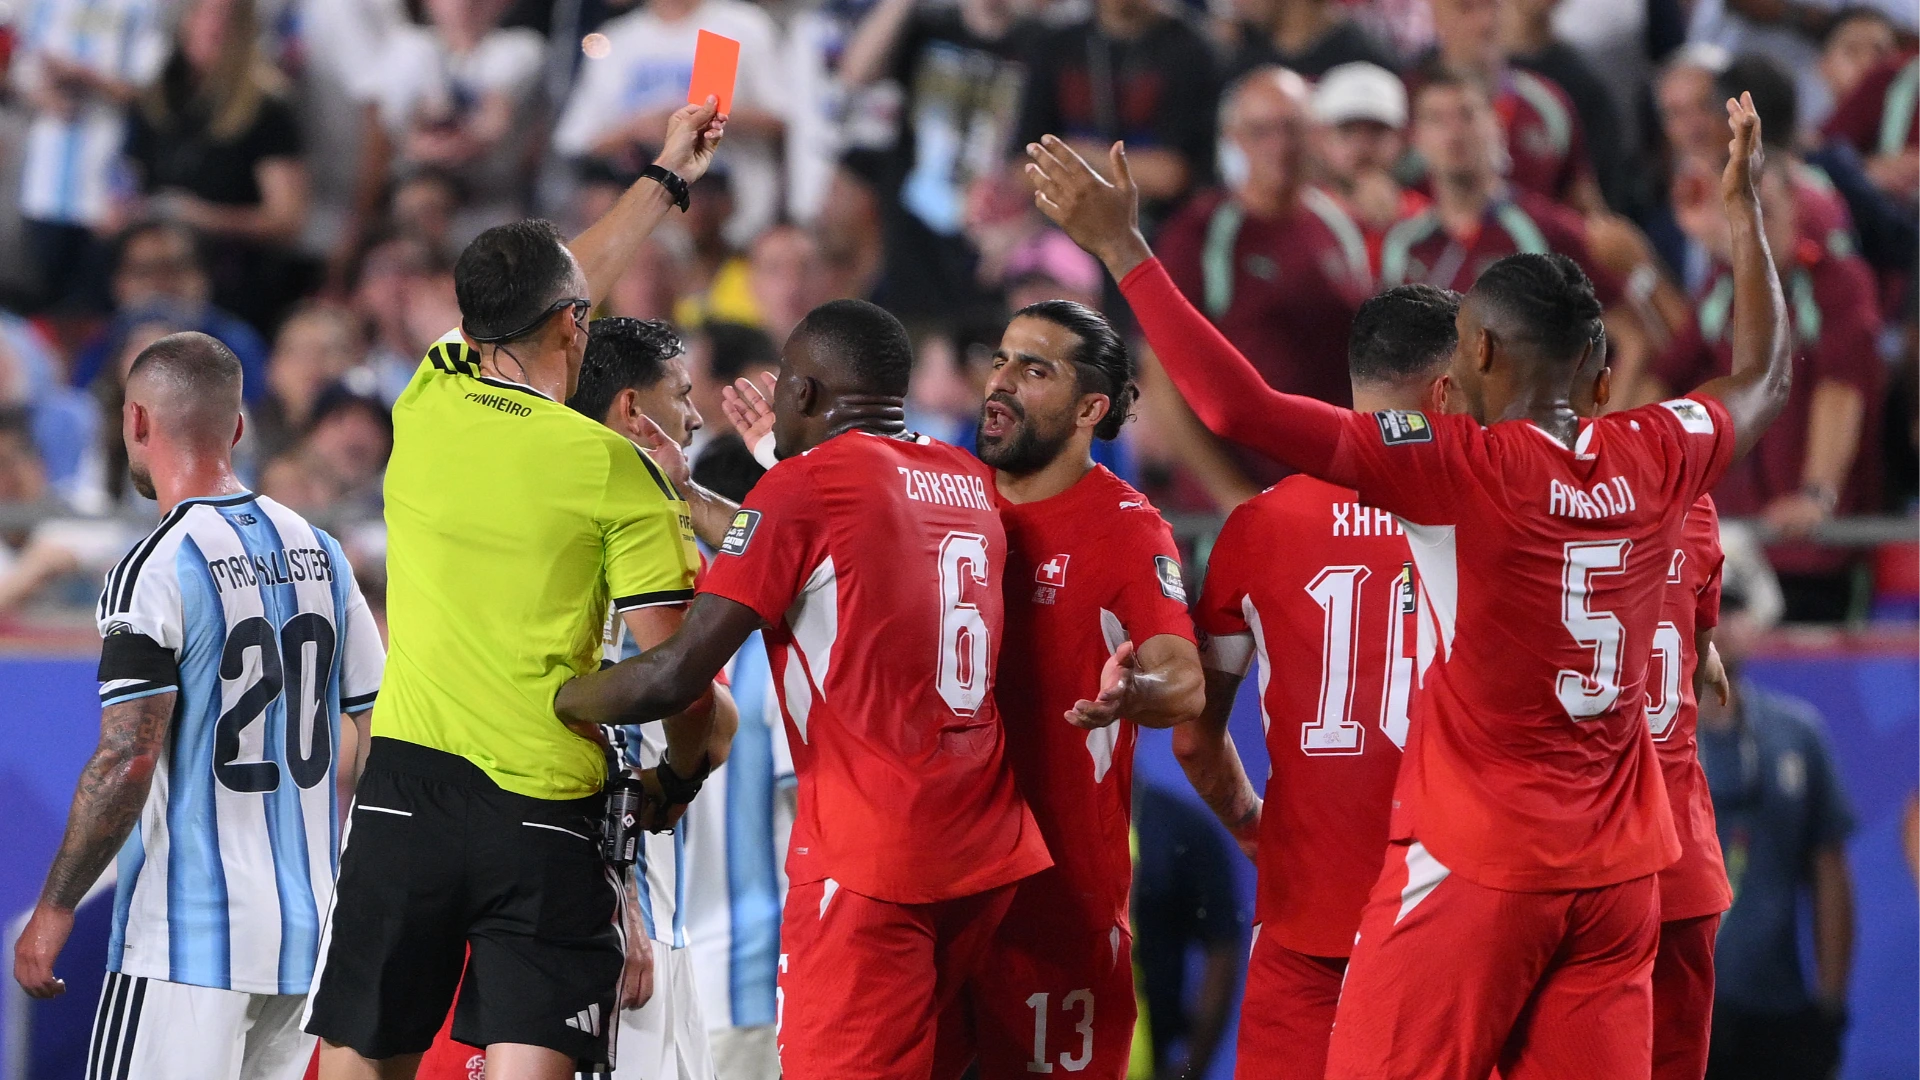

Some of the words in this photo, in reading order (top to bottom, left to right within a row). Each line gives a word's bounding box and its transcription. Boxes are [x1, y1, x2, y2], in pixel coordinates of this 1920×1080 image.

[464, 392, 532, 418] PINHEIRO
[896, 466, 992, 512] ZAKARIA
[1549, 475, 1636, 520] AKANJI
[678, 514, 692, 530] FIF
[208, 554, 257, 594] MAC
[253, 547, 334, 586] ALISTER
[935, 530, 990, 717] 6
[1555, 537, 1635, 724] 5
[211, 612, 337, 794] 20
[1025, 988, 1095, 1074] 13
